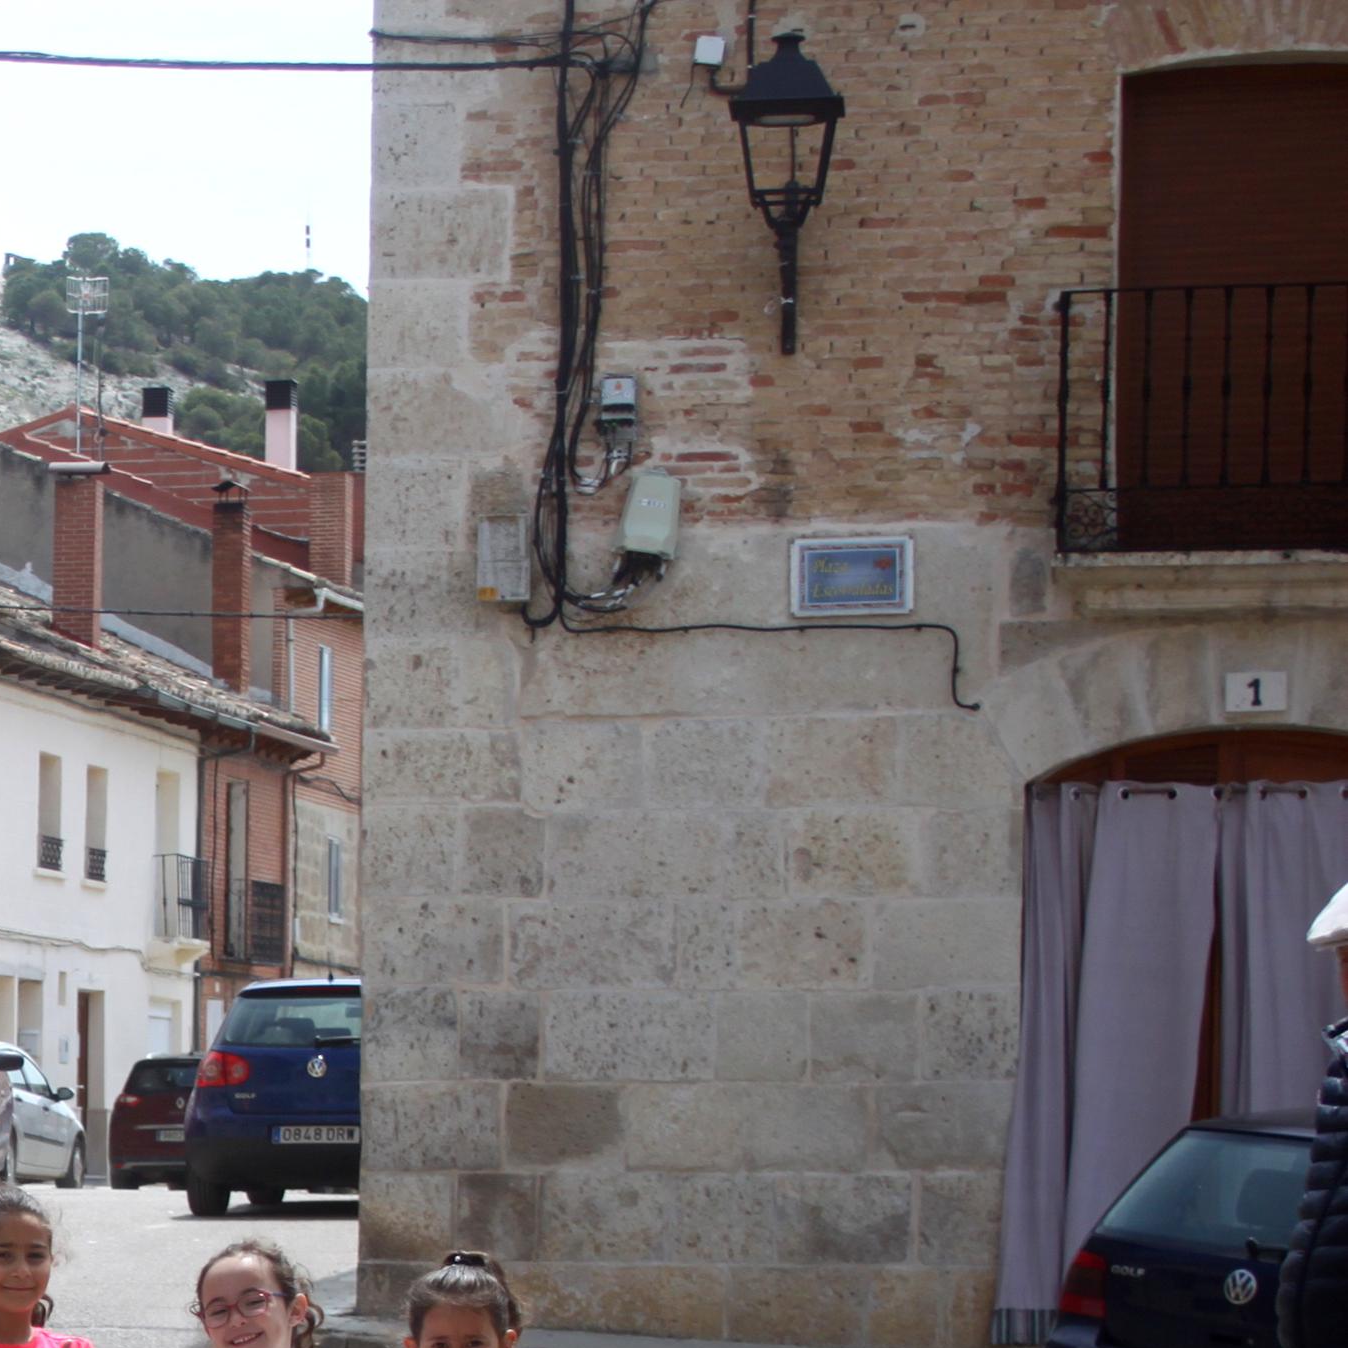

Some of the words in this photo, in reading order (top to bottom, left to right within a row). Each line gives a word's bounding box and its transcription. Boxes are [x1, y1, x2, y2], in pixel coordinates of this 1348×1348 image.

[1246, 677, 1262, 707] 1
[282, 1127, 322, 1142] 0848
[1110, 1265, 1146, 1278] GOLF
